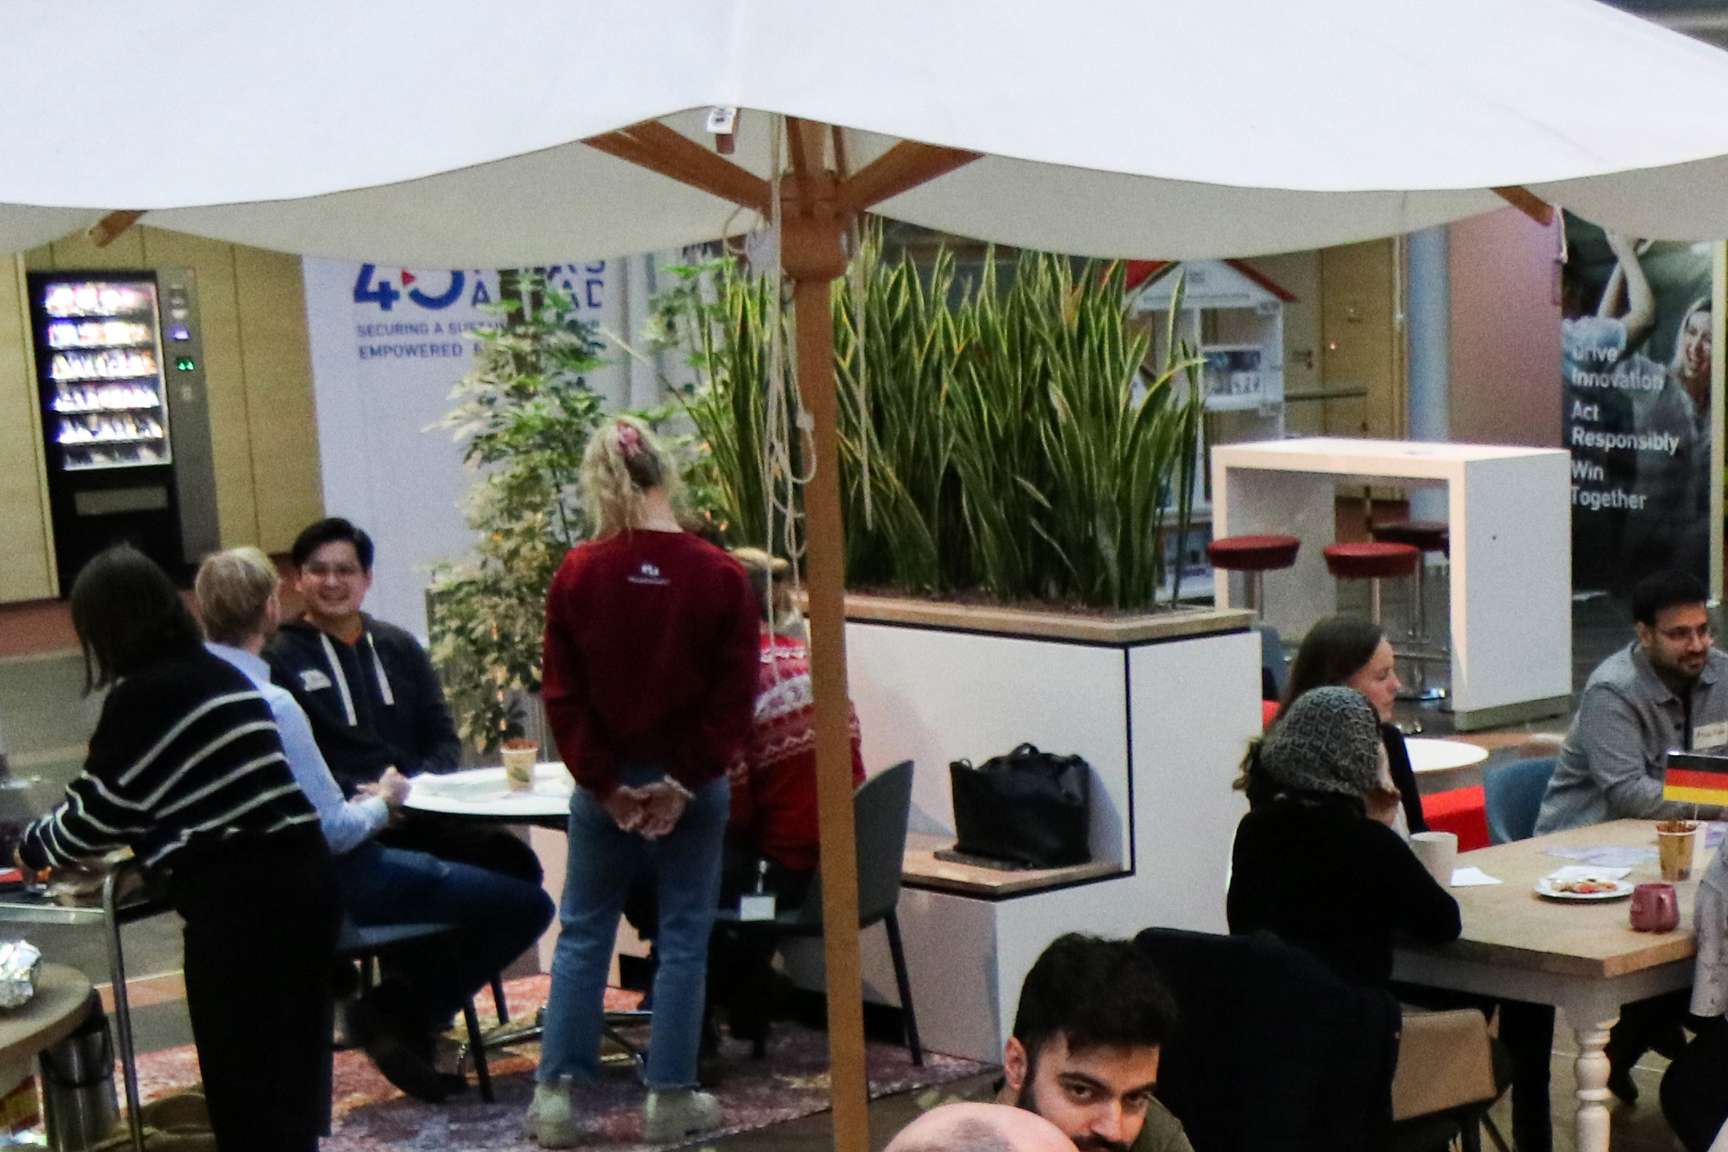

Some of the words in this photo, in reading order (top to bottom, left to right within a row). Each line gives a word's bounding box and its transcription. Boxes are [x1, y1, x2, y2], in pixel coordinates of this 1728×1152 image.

[357, 322, 429, 337] SECURING
[434, 322, 445, 335] A
[359, 342, 463, 360] EMPOWERED
[1571, 367, 1666, 391] Innovation
[1572, 400, 1599, 421] Act
[1572, 426, 1680, 456] Responsibly
[1571, 459, 1604, 481] Win
[1571, 485, 1647, 511] Together
